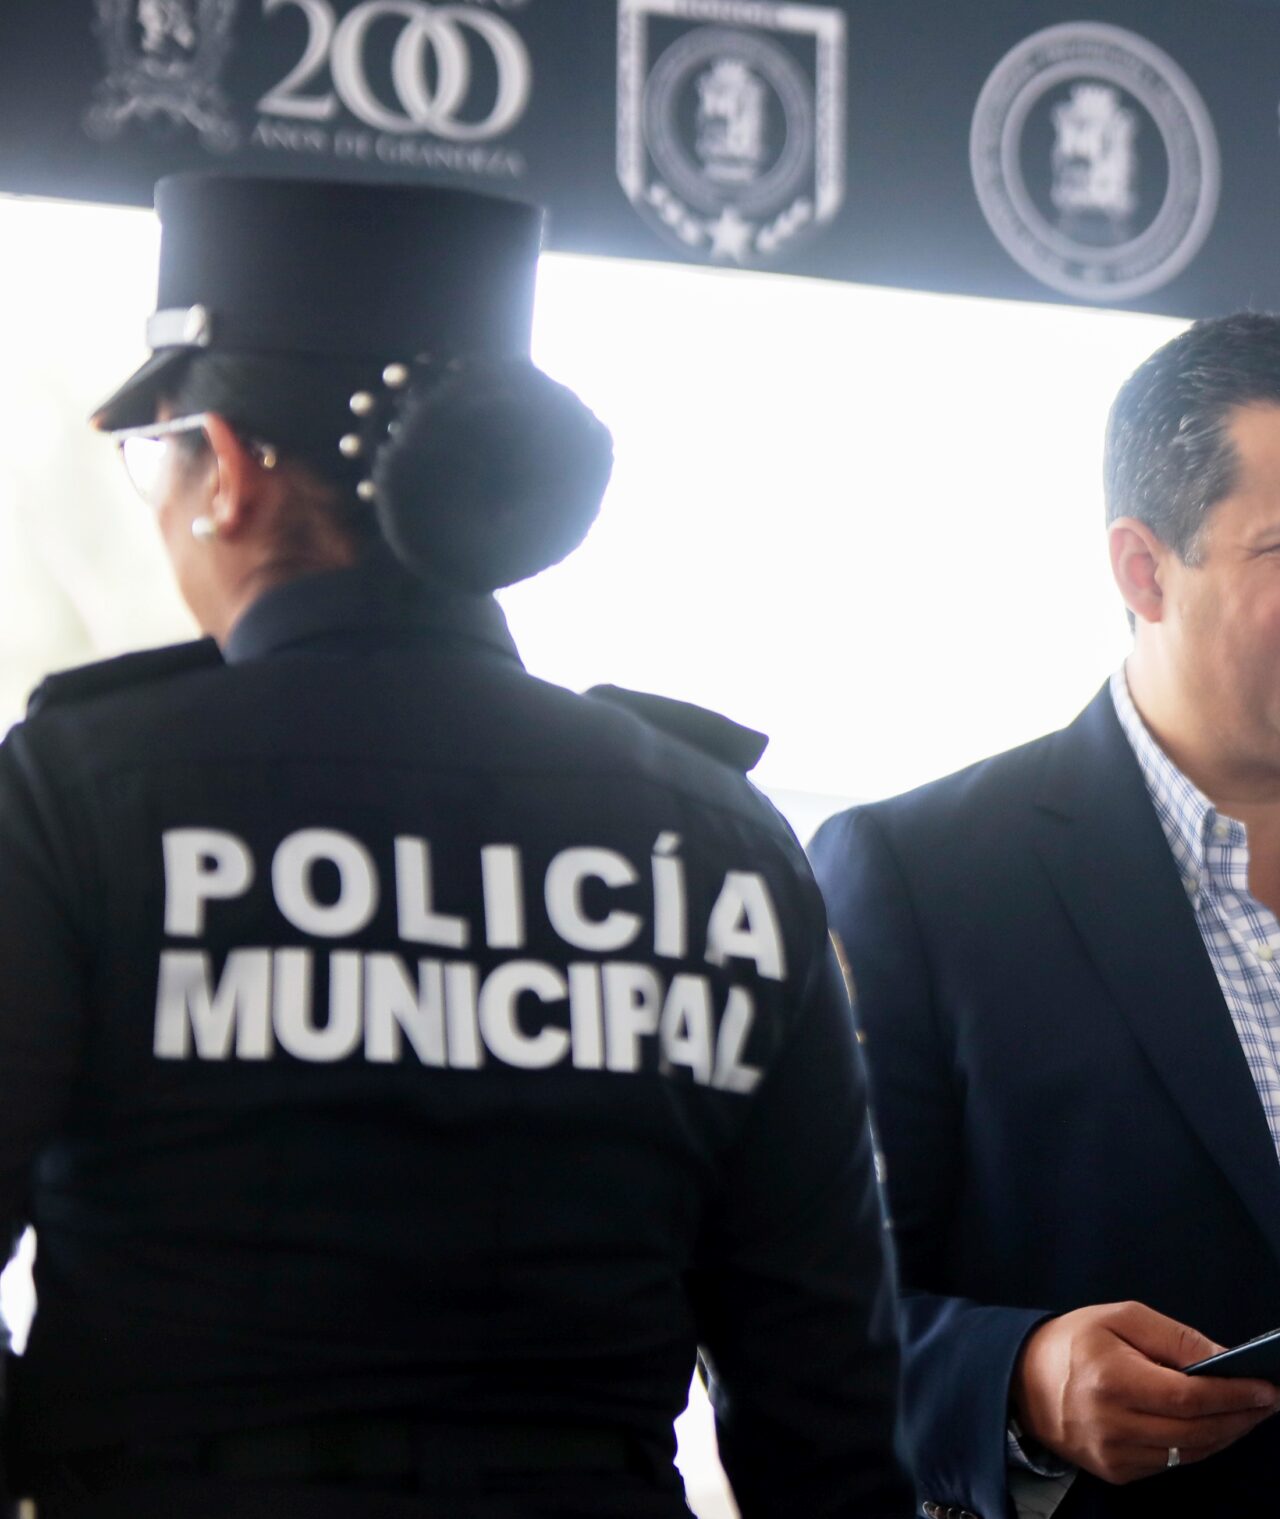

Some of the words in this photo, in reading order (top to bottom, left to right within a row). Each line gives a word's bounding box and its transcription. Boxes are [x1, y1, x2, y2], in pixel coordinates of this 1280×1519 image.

[257, 0, 530, 140] 200
[162, 828, 786, 981] POLICÍA
[153, 947, 764, 1094] MUNICIPAL
